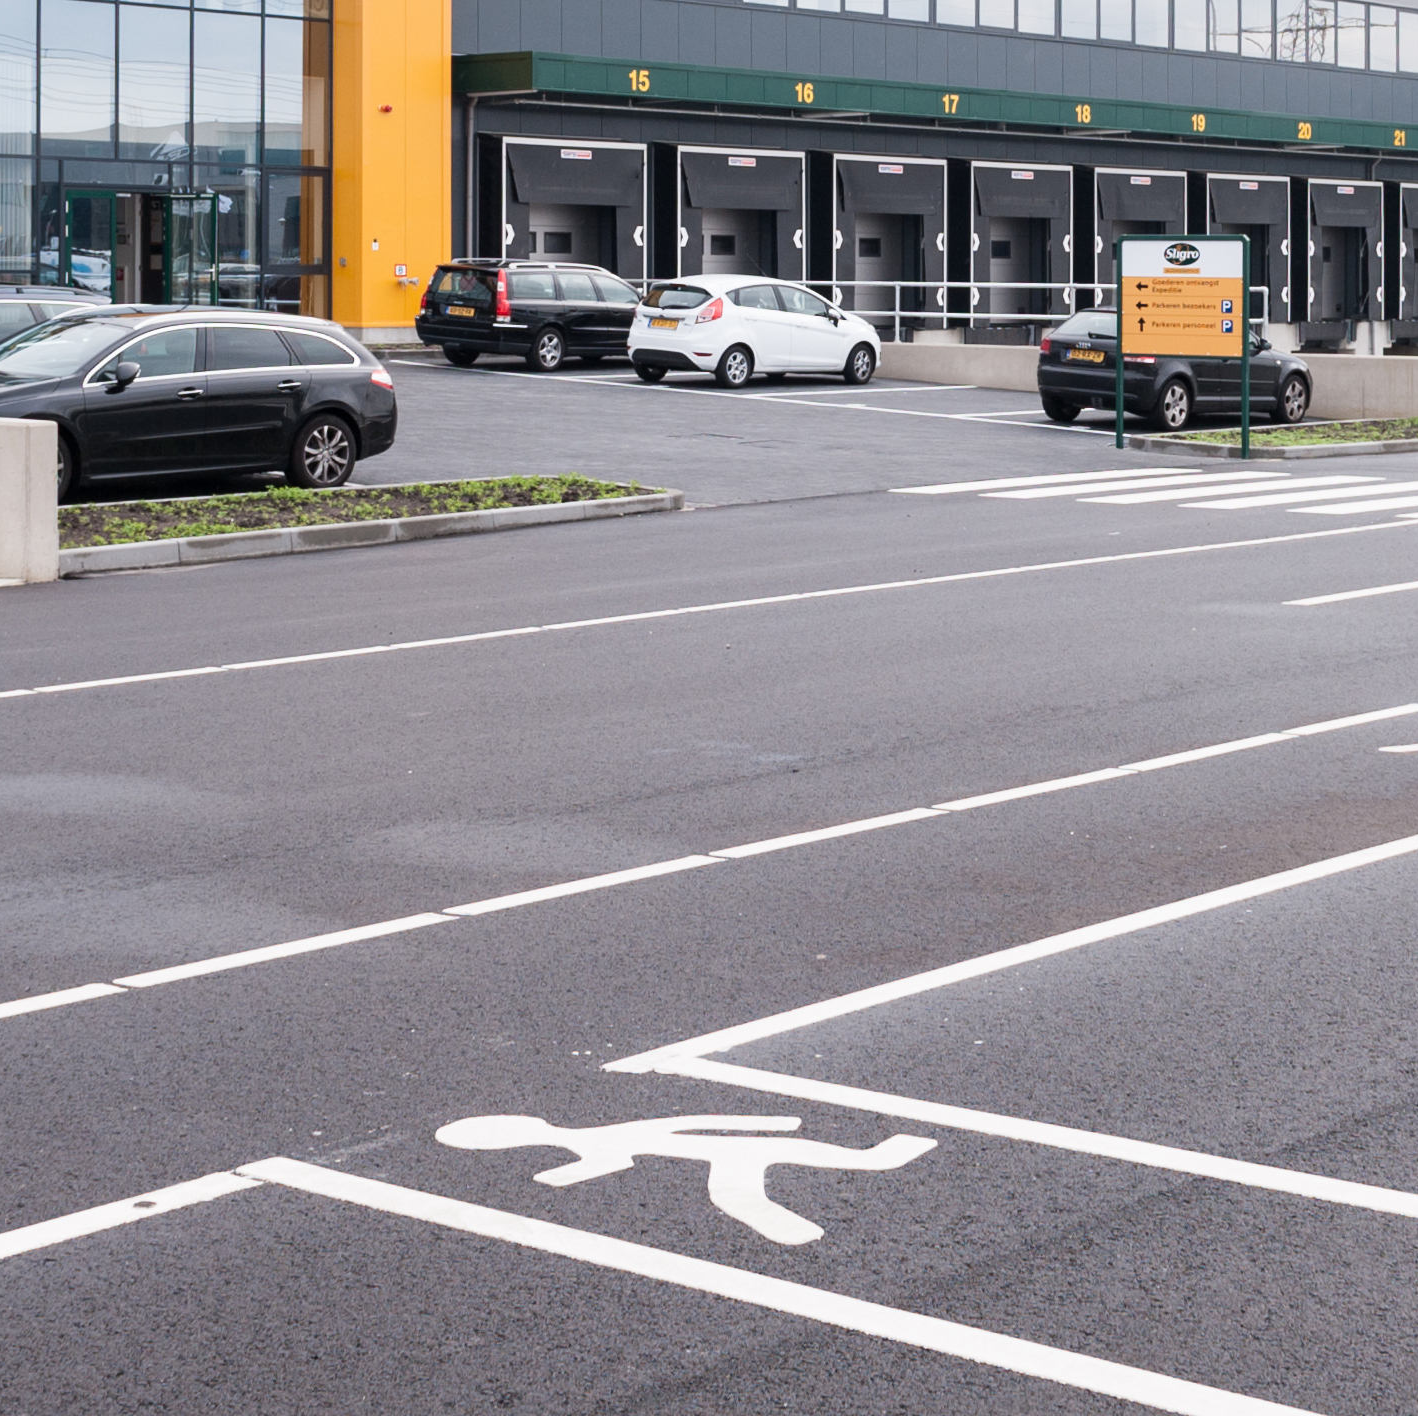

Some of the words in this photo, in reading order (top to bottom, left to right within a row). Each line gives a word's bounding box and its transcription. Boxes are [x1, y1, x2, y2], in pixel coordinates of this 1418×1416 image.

[629, 70, 650, 91] 15
[795, 83, 814, 103] 16
[942, 95, 960, 114] 17
[1075, 105, 1091, 124] 18
[1191, 114, 1206, 132] 19
[1297, 123, 1312, 140] 20
[1393, 130, 1407, 147] 21
[1165, 247, 1199, 261] Sligro
[1186, 280, 1219, 288] ontvangst
[1182, 302, 1216, 310] bezoekers
[1222, 300, 1232, 313] P
[1182, 322, 1216, 330] personeel
[1222, 320, 1232, 333] P
